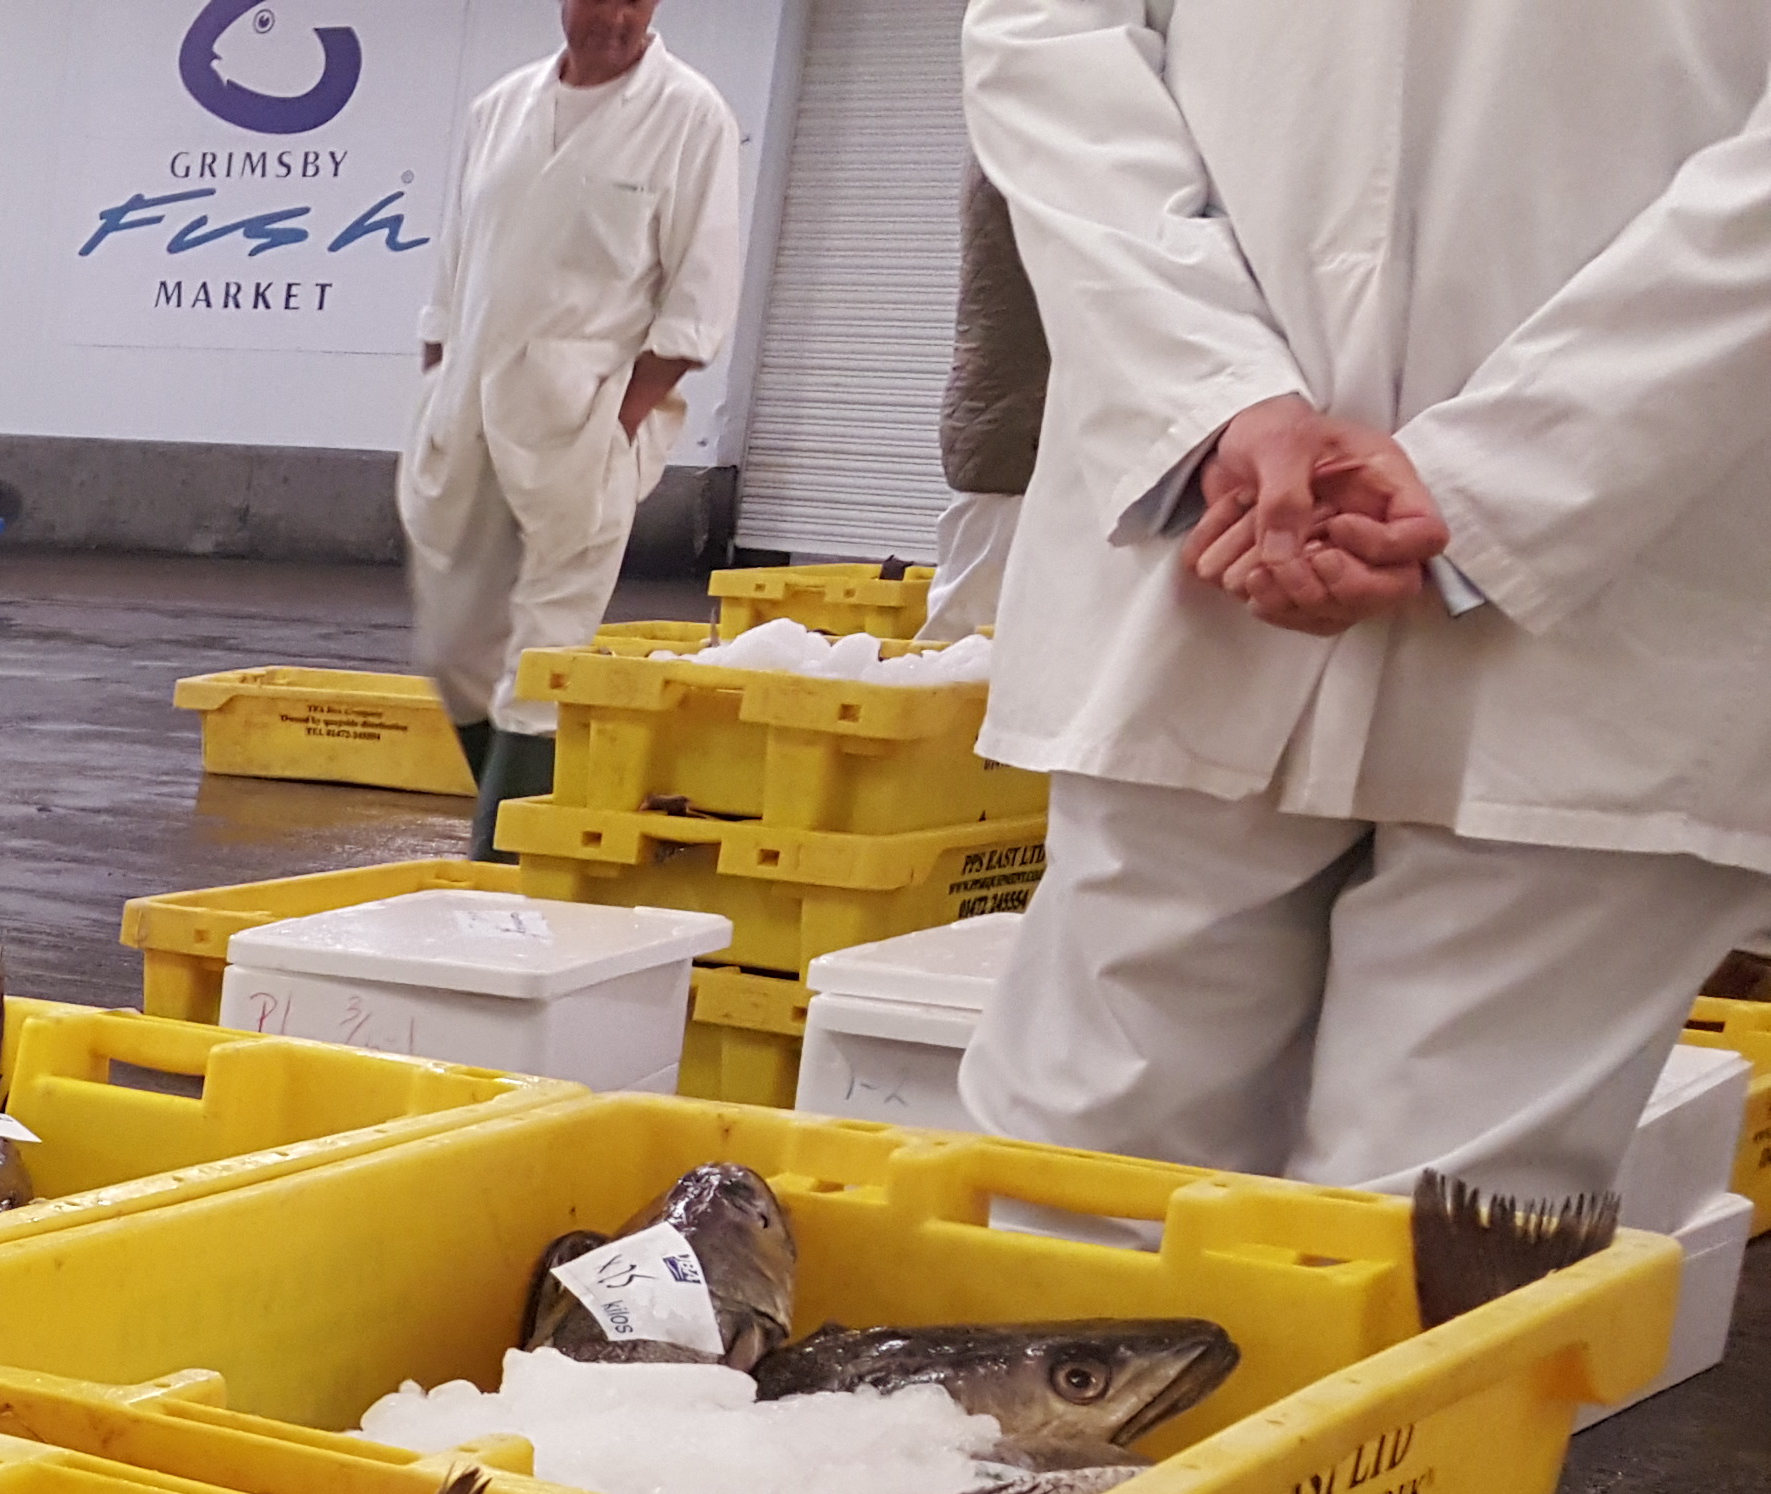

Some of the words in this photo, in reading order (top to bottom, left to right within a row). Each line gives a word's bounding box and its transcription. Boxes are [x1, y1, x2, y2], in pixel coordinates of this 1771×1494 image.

[170, 151, 348, 178] GRIMSBY
[78, 188, 430, 256] Fish
[155, 281, 333, 311] MARKET
[602, 1300, 634, 1334] kilos
